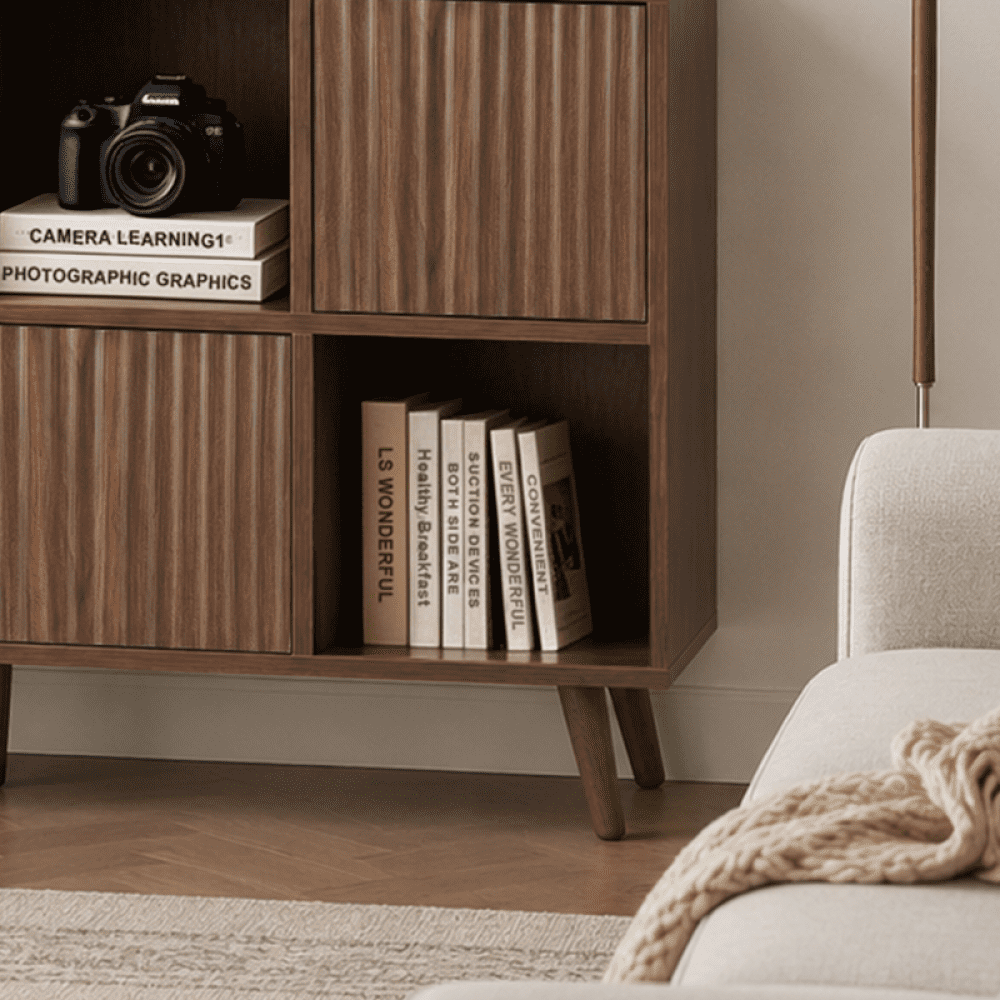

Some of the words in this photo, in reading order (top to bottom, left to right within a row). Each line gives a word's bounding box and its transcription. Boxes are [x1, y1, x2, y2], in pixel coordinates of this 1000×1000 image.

[29, 227, 112, 246] CAMERA
[2, 265, 151, 287] PHOTOGRAPHIC
[155, 270, 252, 290] GRAPHICS
[378, 447, 394, 472] LS
[415, 449, 432, 515] Healthy
[447, 462, 460, 510] BOTH
[468, 452, 480, 529] SUCTION
[500, 460, 516, 516] EVERY
[378, 478, 394, 603] WONDERFUL
[447, 515, 460, 555] SIDE
[527, 474, 549, 595] CONVENIENT
[447, 560, 460, 595] ARE
[468, 535, 480, 609] DEVICES
[505, 522, 526, 630] WONDERFUL
